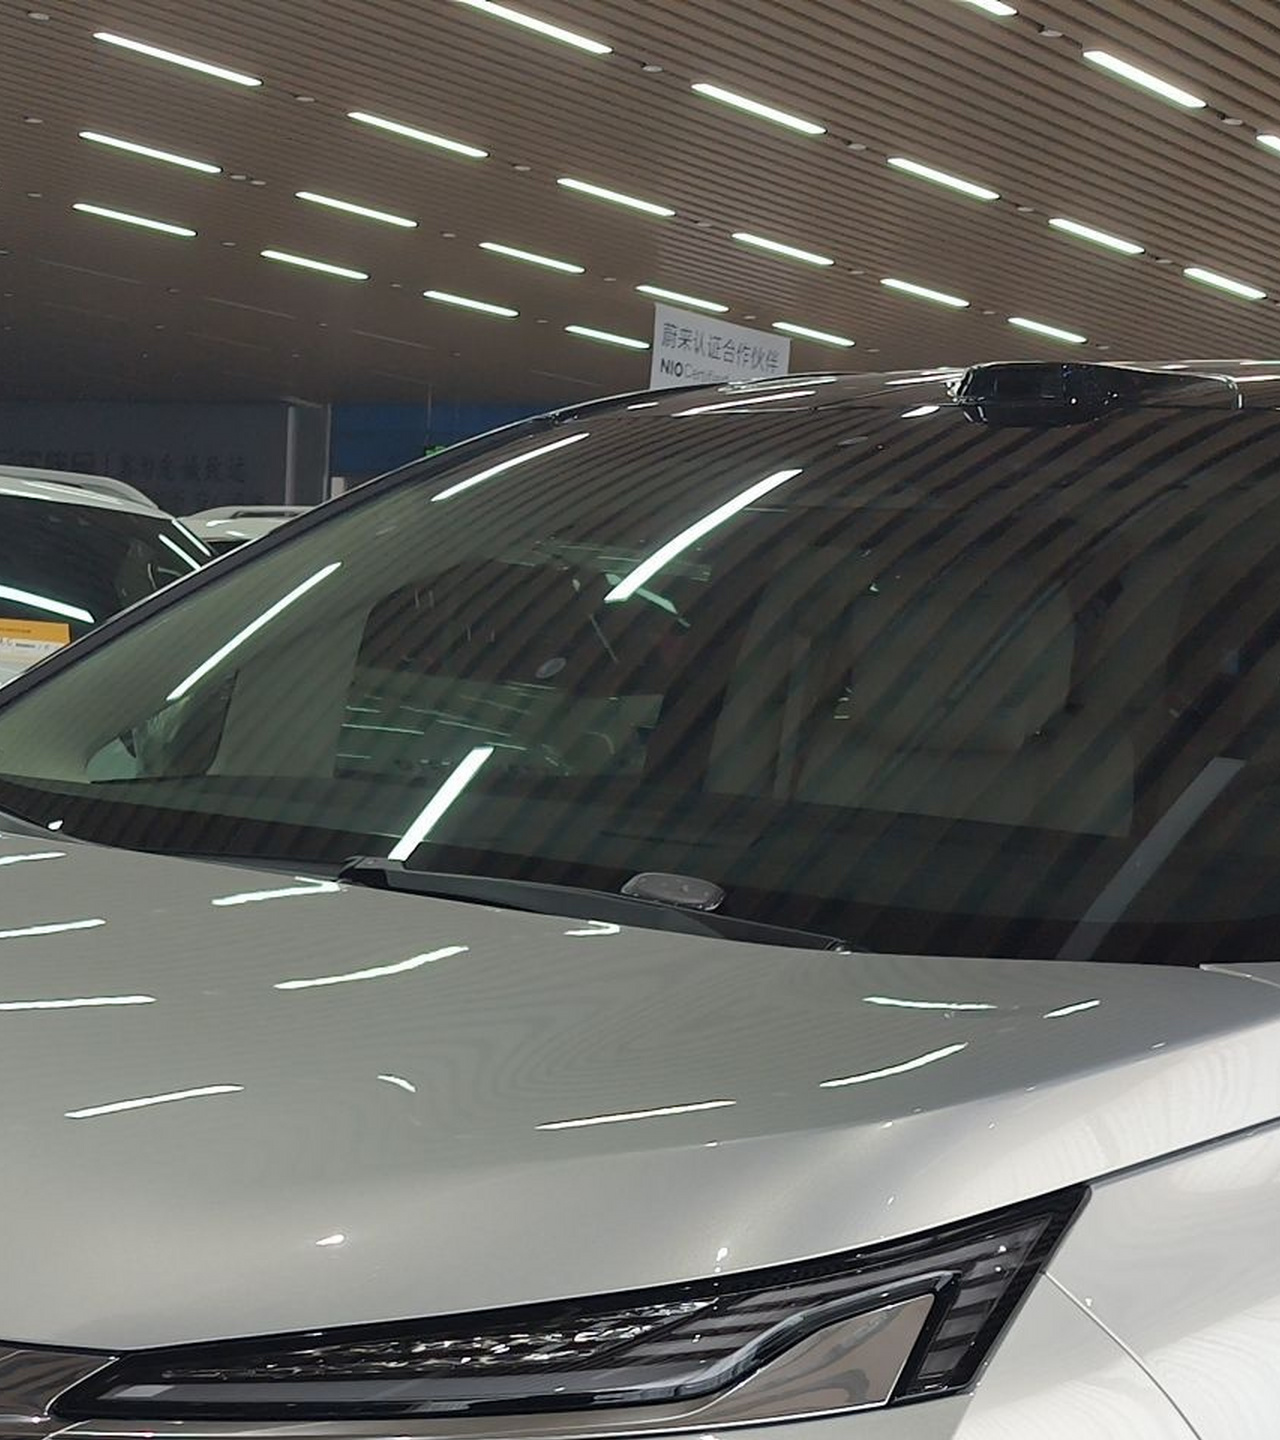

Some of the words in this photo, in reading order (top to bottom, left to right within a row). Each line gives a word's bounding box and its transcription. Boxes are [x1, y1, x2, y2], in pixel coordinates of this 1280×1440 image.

[661, 323, 780, 374] 蔚来认证合作伙伴
[660, 357, 684, 378] NIO
